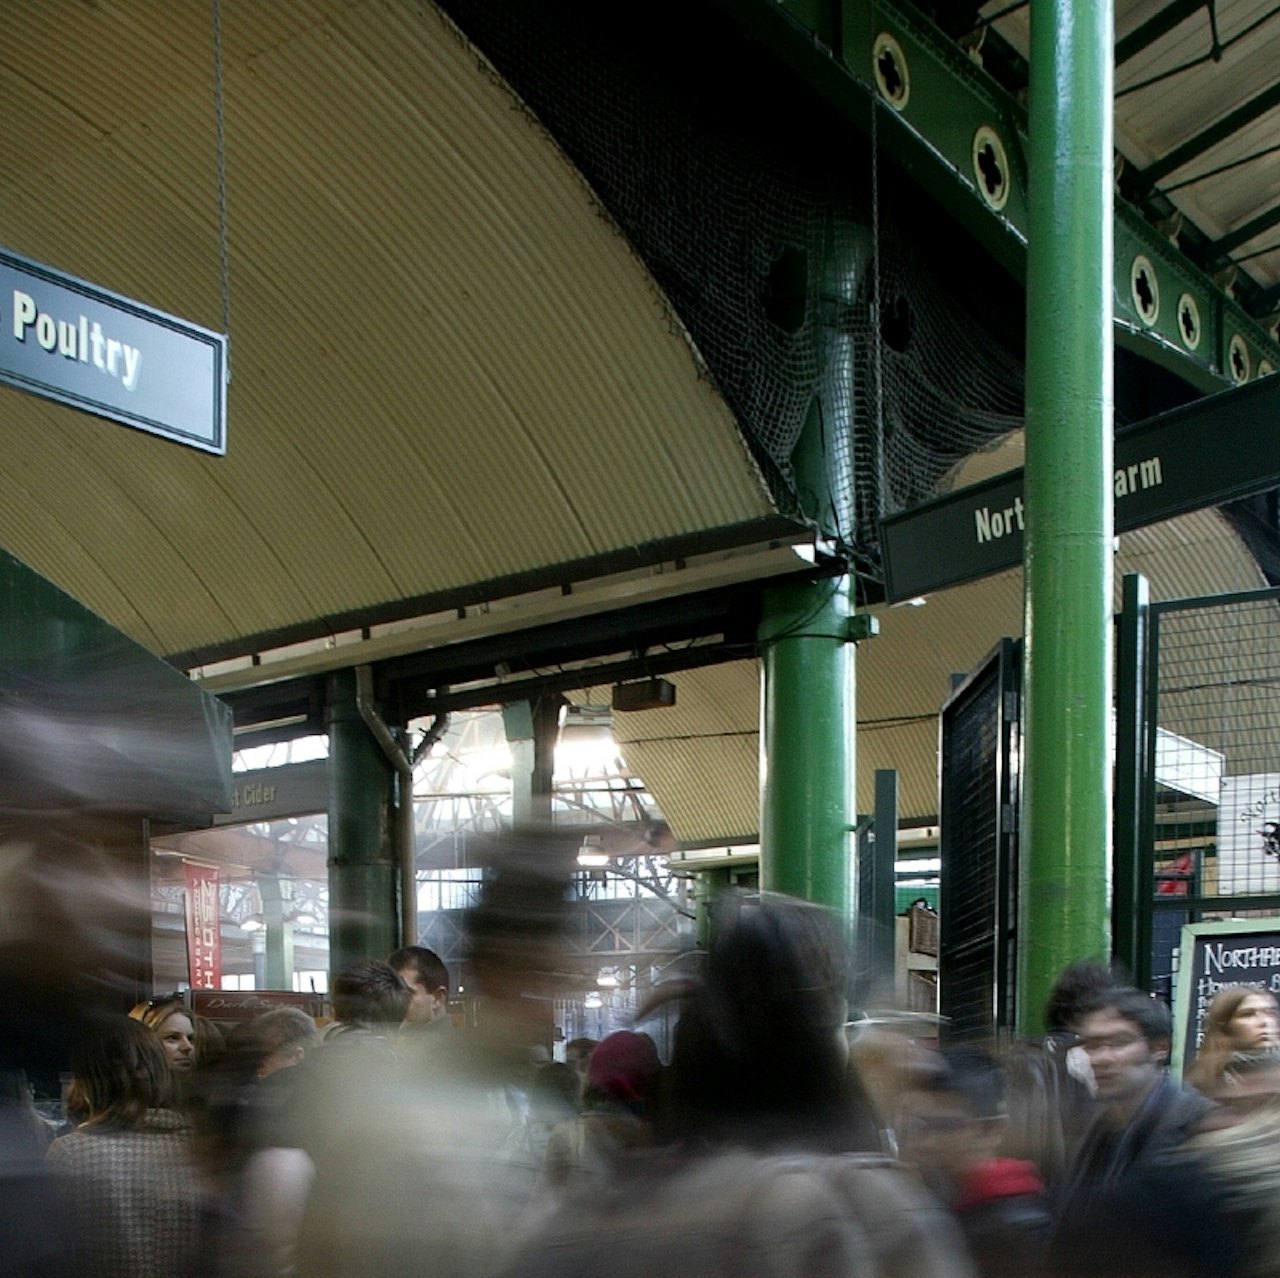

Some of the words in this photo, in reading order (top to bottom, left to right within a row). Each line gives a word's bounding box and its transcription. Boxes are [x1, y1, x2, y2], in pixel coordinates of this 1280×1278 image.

[12, 288, 142, 392] Poultry
[1114, 456, 1163, 498] arm
[243, 782, 277, 807] Cider
